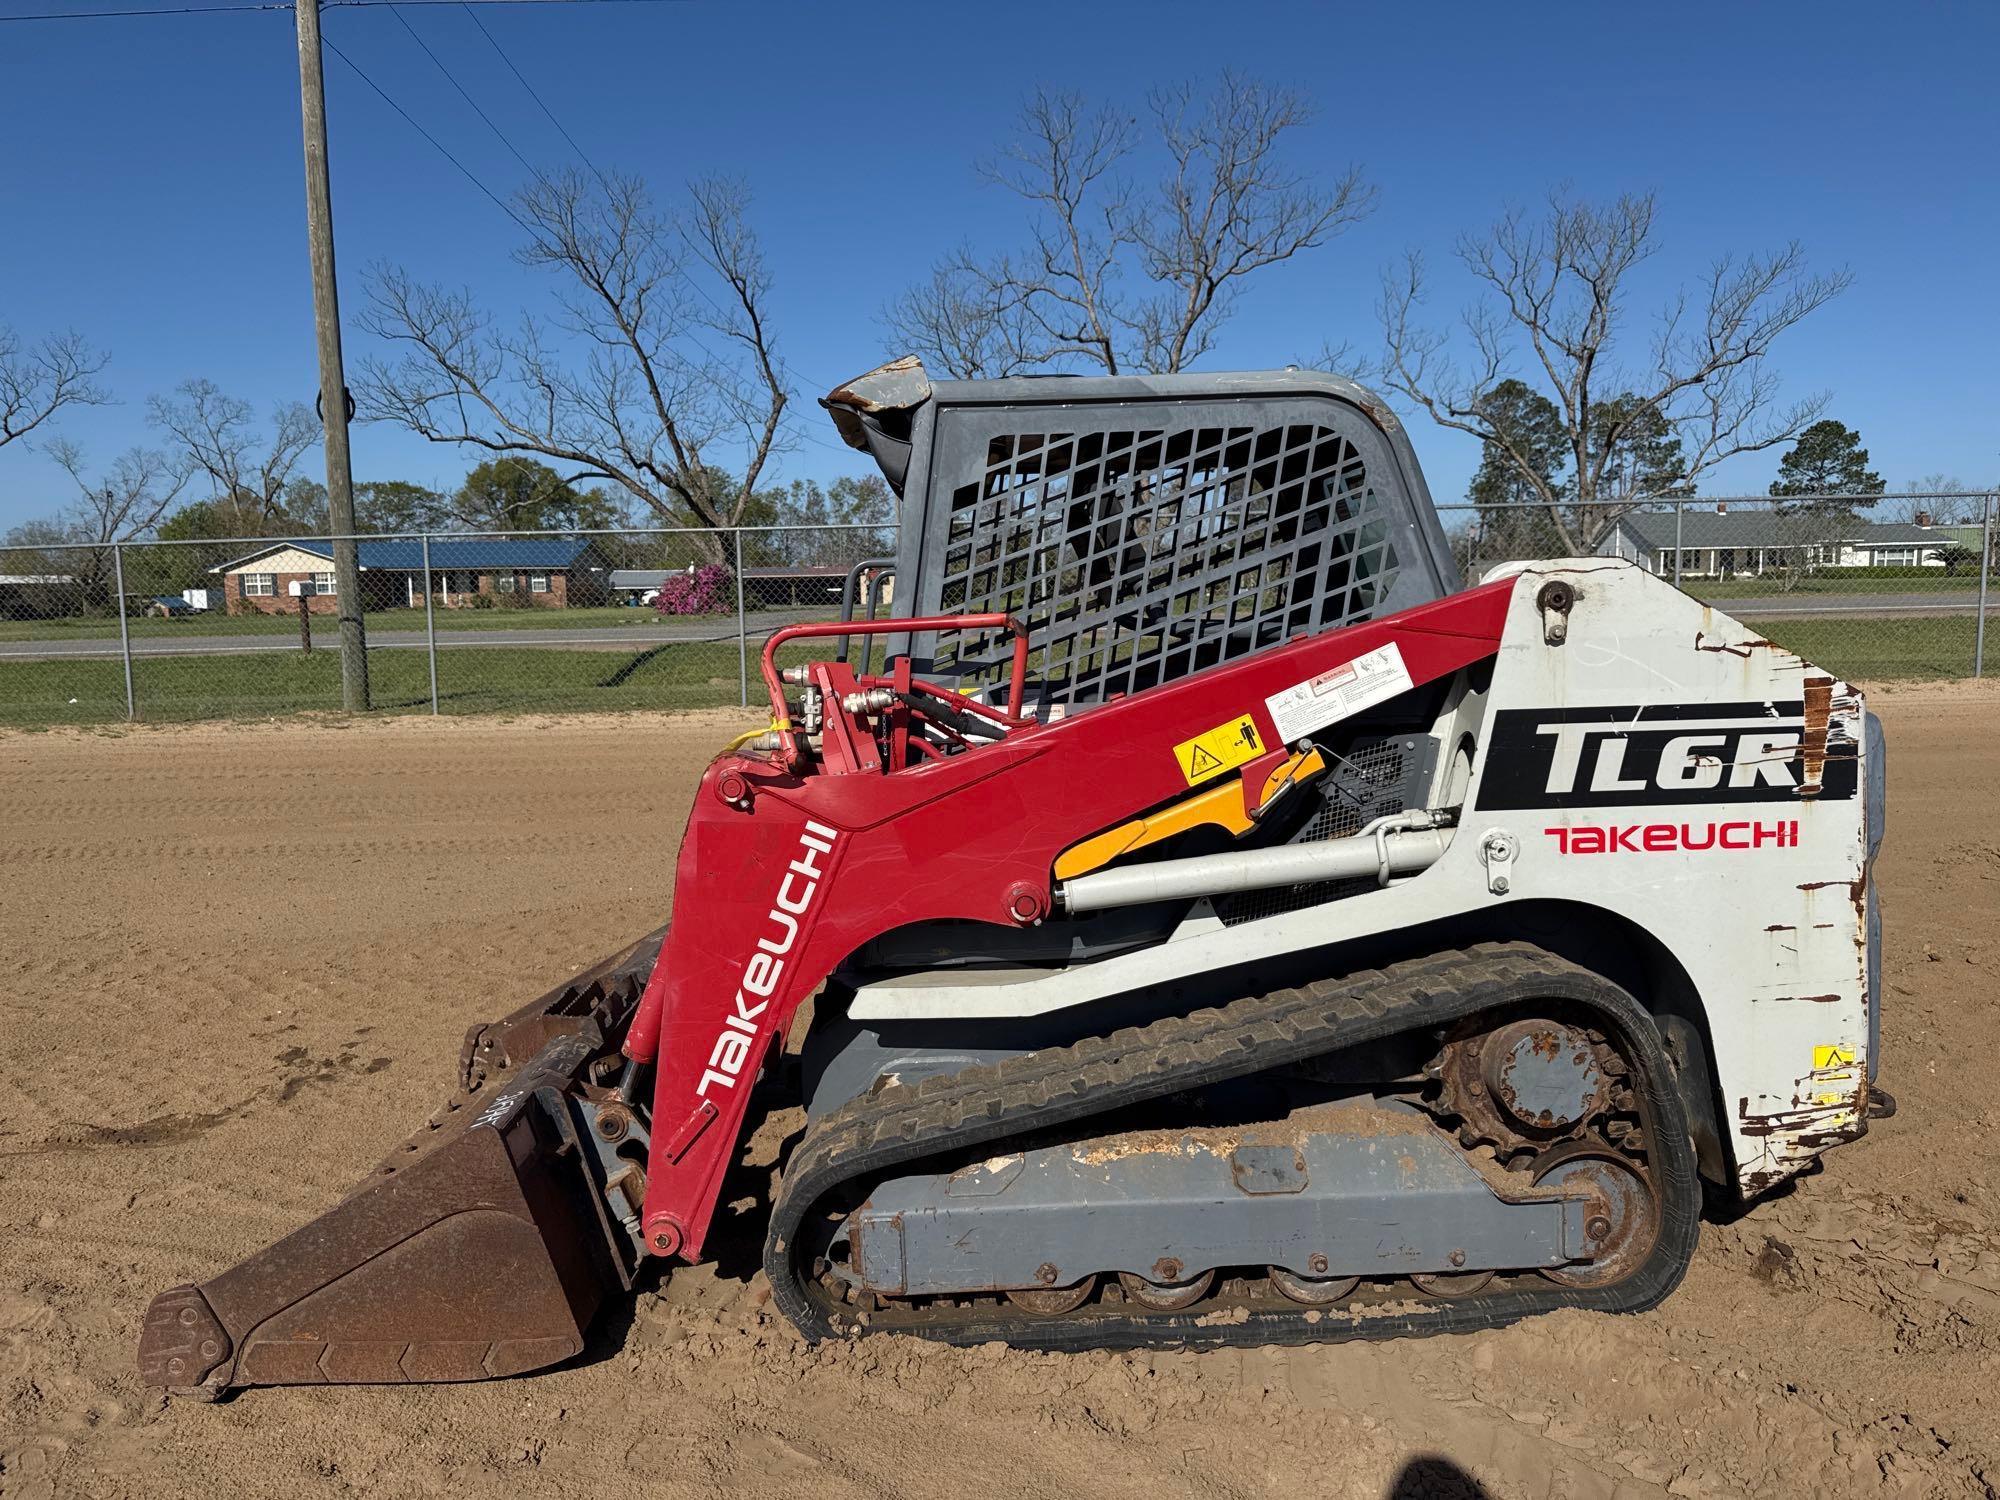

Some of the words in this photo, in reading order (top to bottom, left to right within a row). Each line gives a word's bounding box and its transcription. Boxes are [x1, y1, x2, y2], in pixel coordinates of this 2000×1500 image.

[1536, 723, 1801, 793] TL6R
[1544, 820, 1799, 855] TAKEUCHI
[696, 820, 838, 1096] TAKEUCHI
